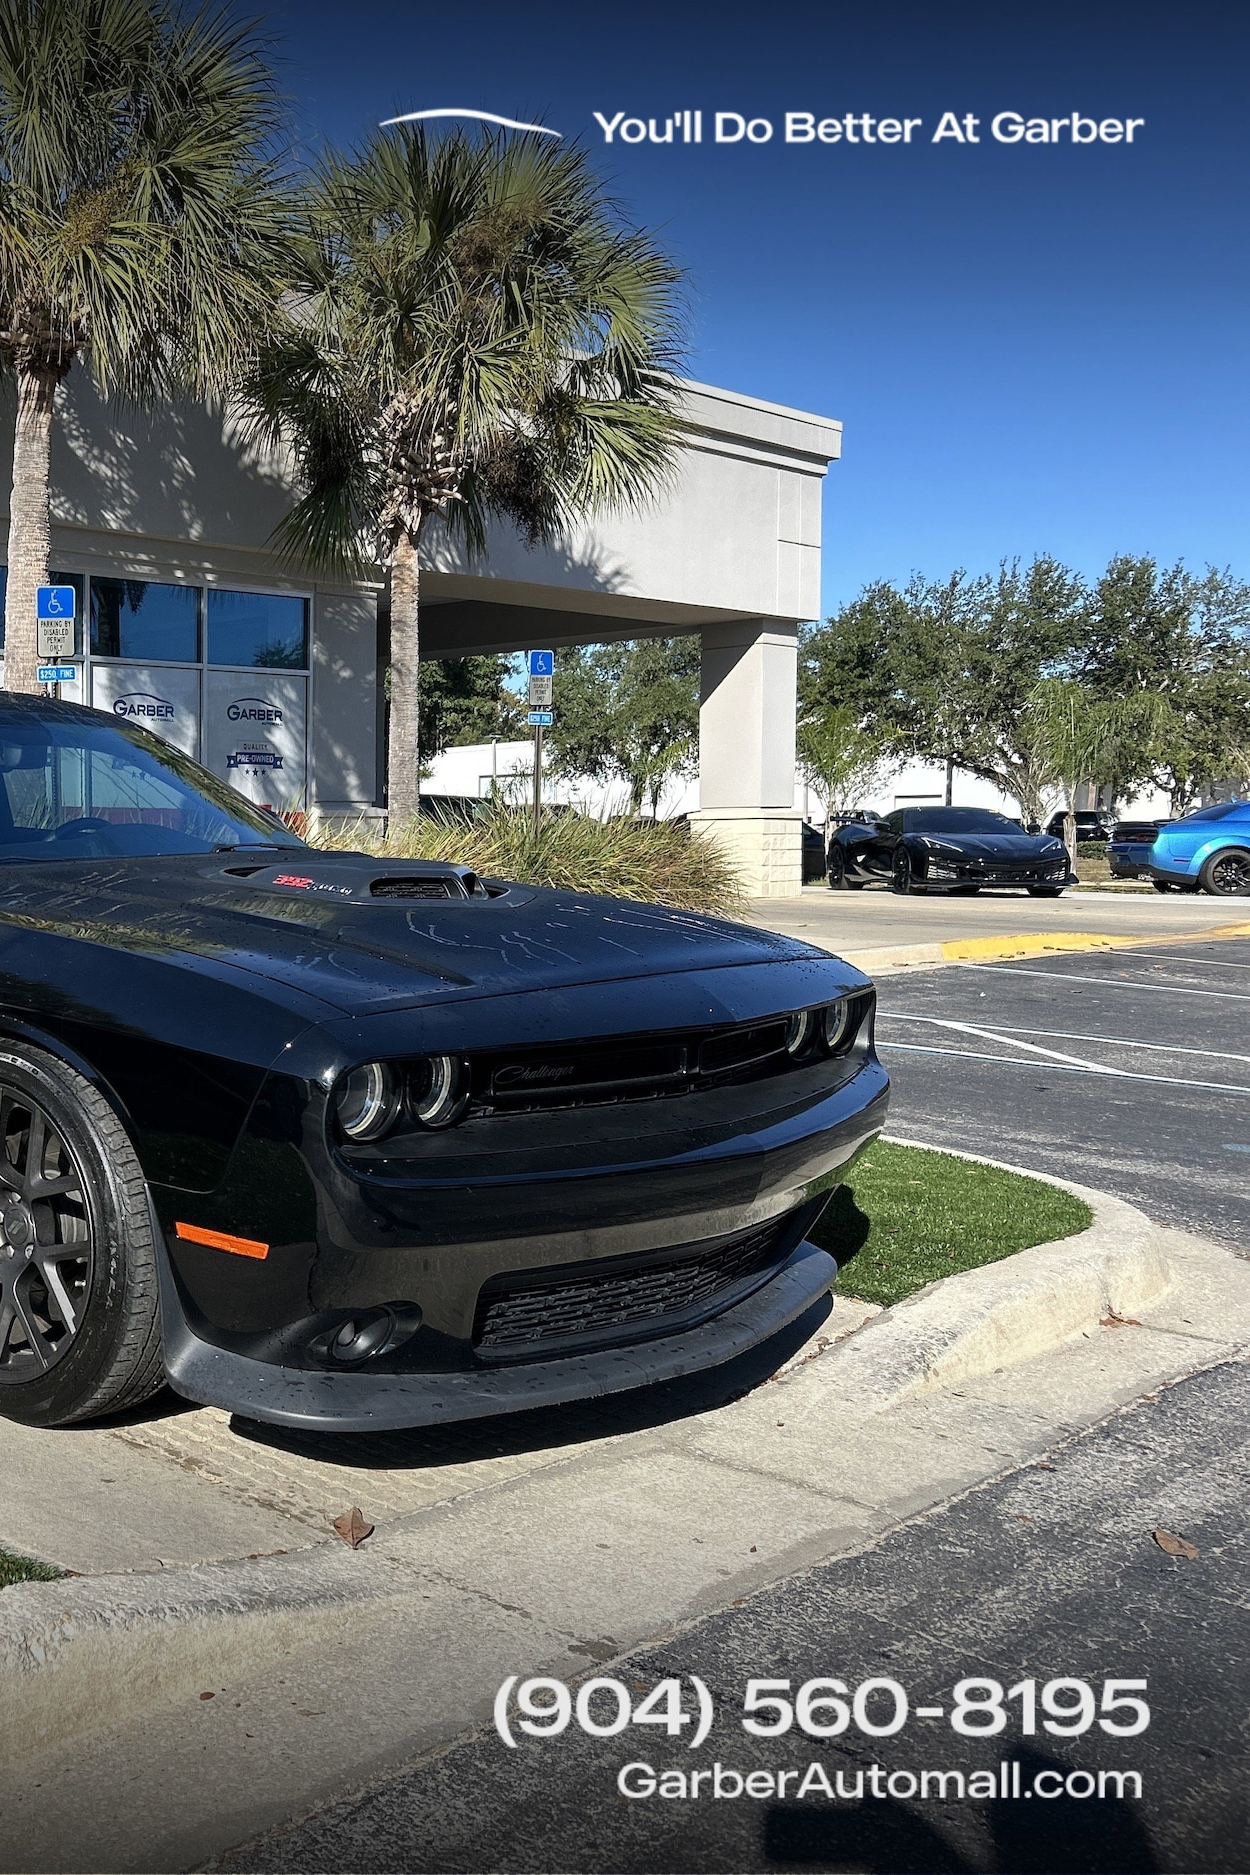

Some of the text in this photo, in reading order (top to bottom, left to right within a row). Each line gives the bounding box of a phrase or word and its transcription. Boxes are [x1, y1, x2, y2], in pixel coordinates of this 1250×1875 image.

[40, 620, 71, 628] PARKING BY
[43, 628, 69, 636] DISABLED
[46, 636, 66, 644] PERMIT
[49, 644, 63, 652] ONLY
[40, 669, 74, 679] $250 FINE
[113, 700, 175, 718] GARBER
[227, 704, 284, 722] GARBER
[243, 743, 269, 751] QUALITY
[236, 753, 275, 763] PRE-OWNED
[494, 1065, 574, 1084] Challenger
